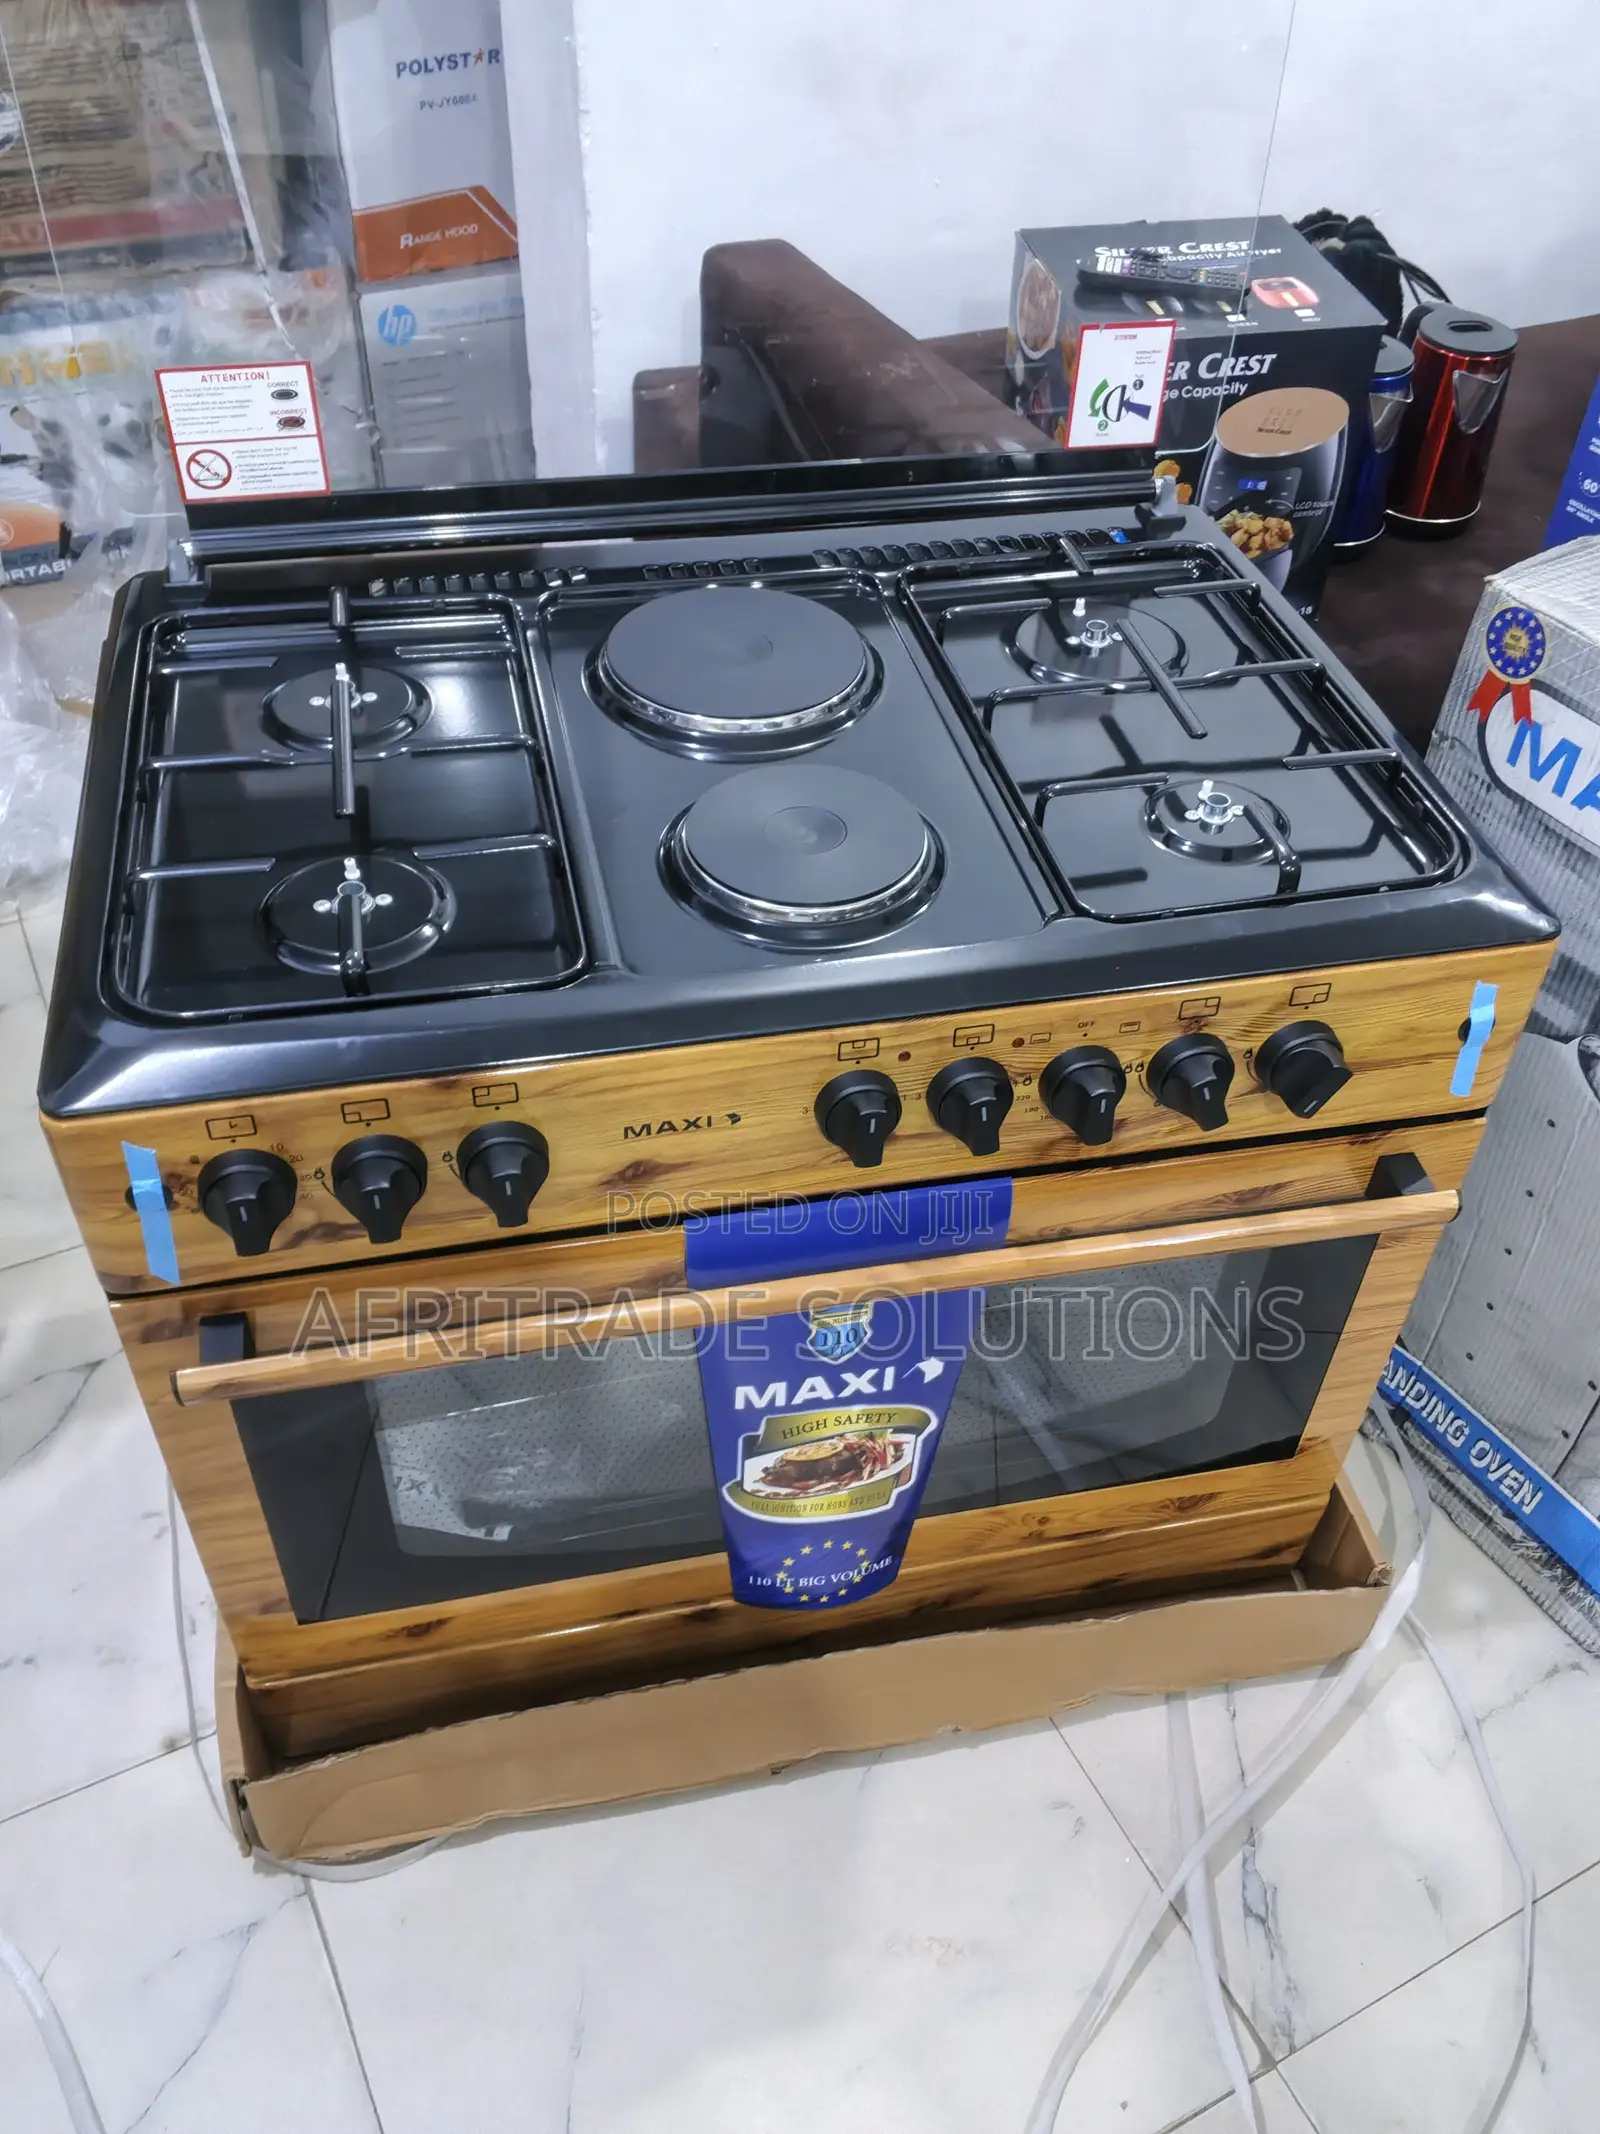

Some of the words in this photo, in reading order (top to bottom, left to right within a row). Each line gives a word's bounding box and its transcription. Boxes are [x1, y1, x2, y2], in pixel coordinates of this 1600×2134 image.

[400, 232, 442, 249] RANGE
[445, 223, 478, 238] HOOD
[1179, 240, 1250, 254] CREST
[380, 304, 415, 346] hp
[200, 371, 270, 383] ATTENTION!
[1198, 352, 1278, 380] CREST
[1181, 382, 1248, 400] Capacity
[624, 1116, 712, 1139] MAXI
[734, 1365, 895, 1410] MAXI
[781, 1417, 828, 1440] HIGH
[833, 1412, 898, 1427] SAFETY
[1382, 1359, 1470, 1448] ANDING
[1469, 1436, 1544, 1515] OVEN
[798, 1575, 827, 1588] BIG
[830, 1555, 893, 1583] VOLUME
